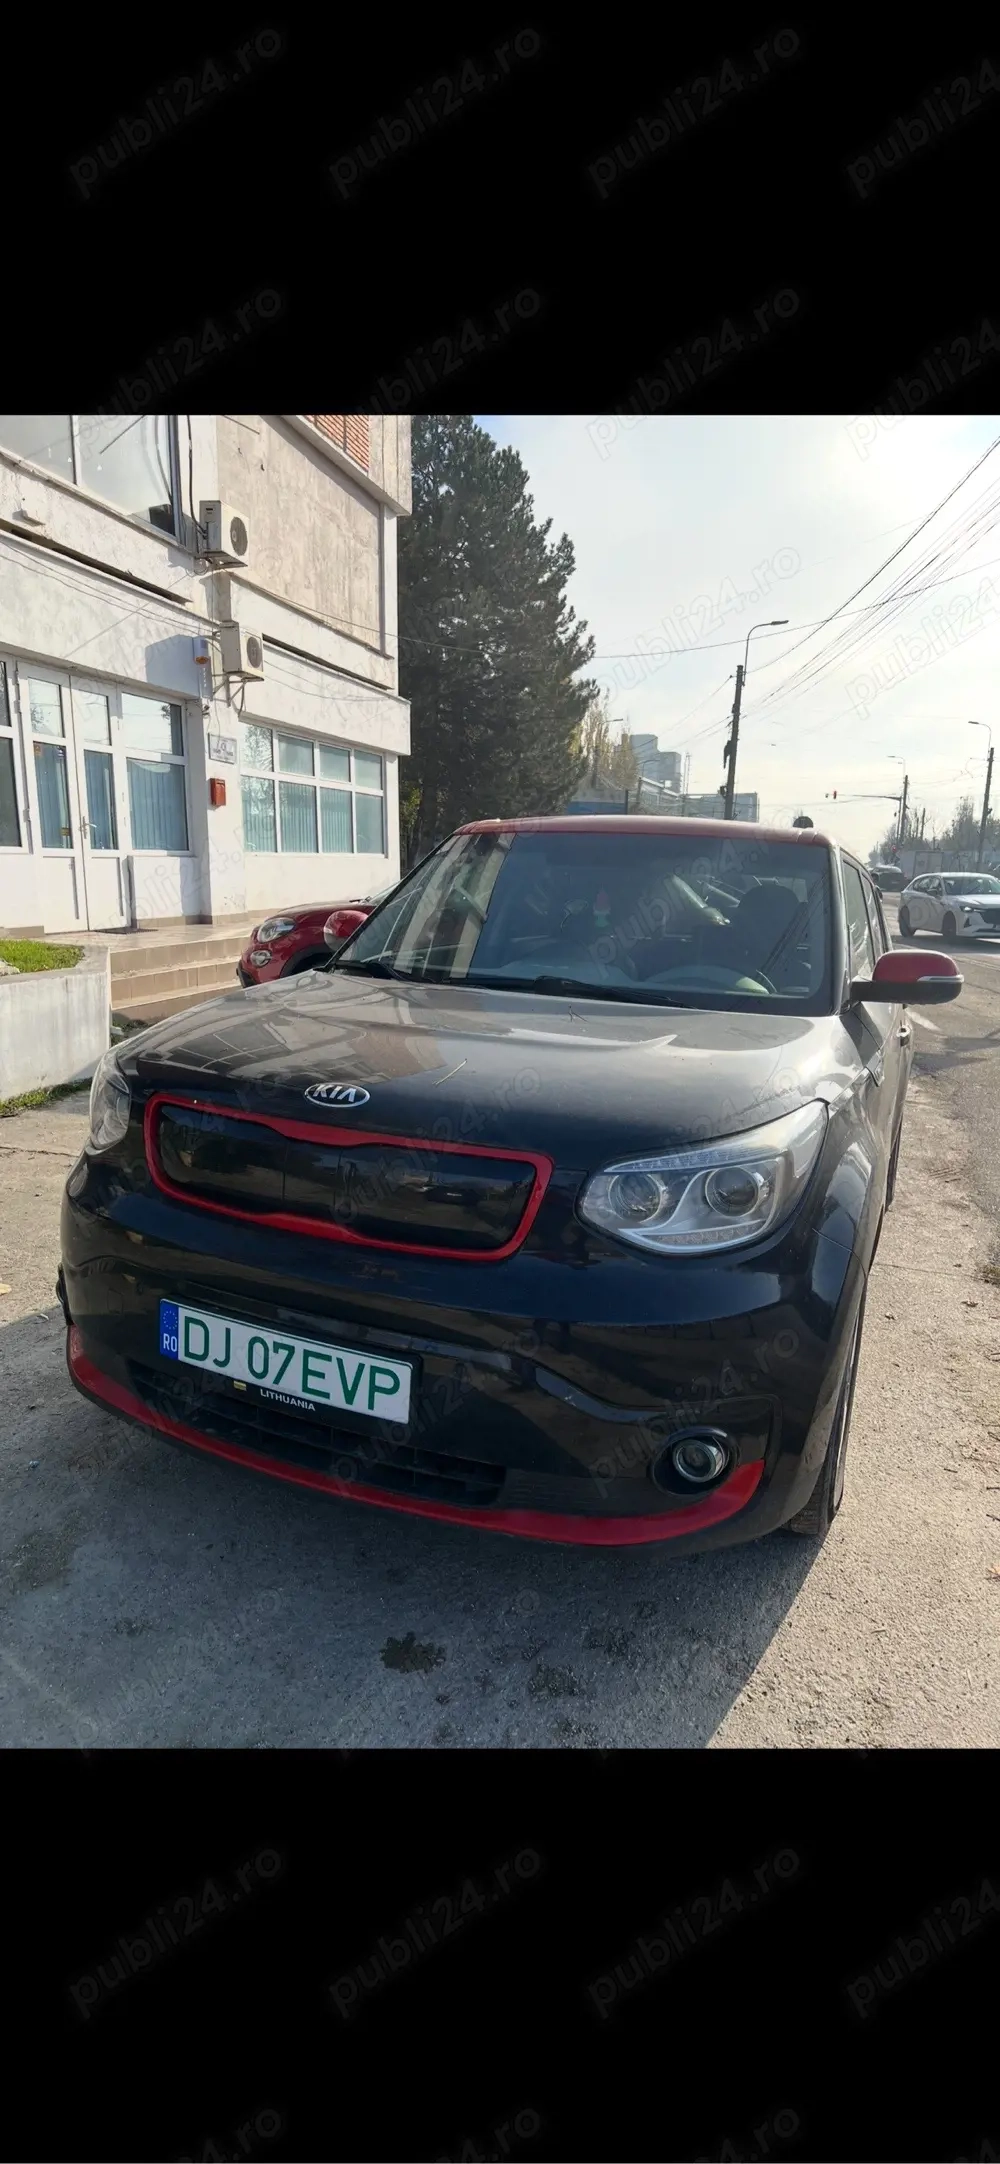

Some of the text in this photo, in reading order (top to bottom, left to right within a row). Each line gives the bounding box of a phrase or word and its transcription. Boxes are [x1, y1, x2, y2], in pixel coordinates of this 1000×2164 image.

[312, 1084, 357, 1103] KIA
[162, 1333, 178, 1353] RO
[184, 1315, 231, 1368] DJ
[260, 1388, 316, 1412] LITHUANIA
